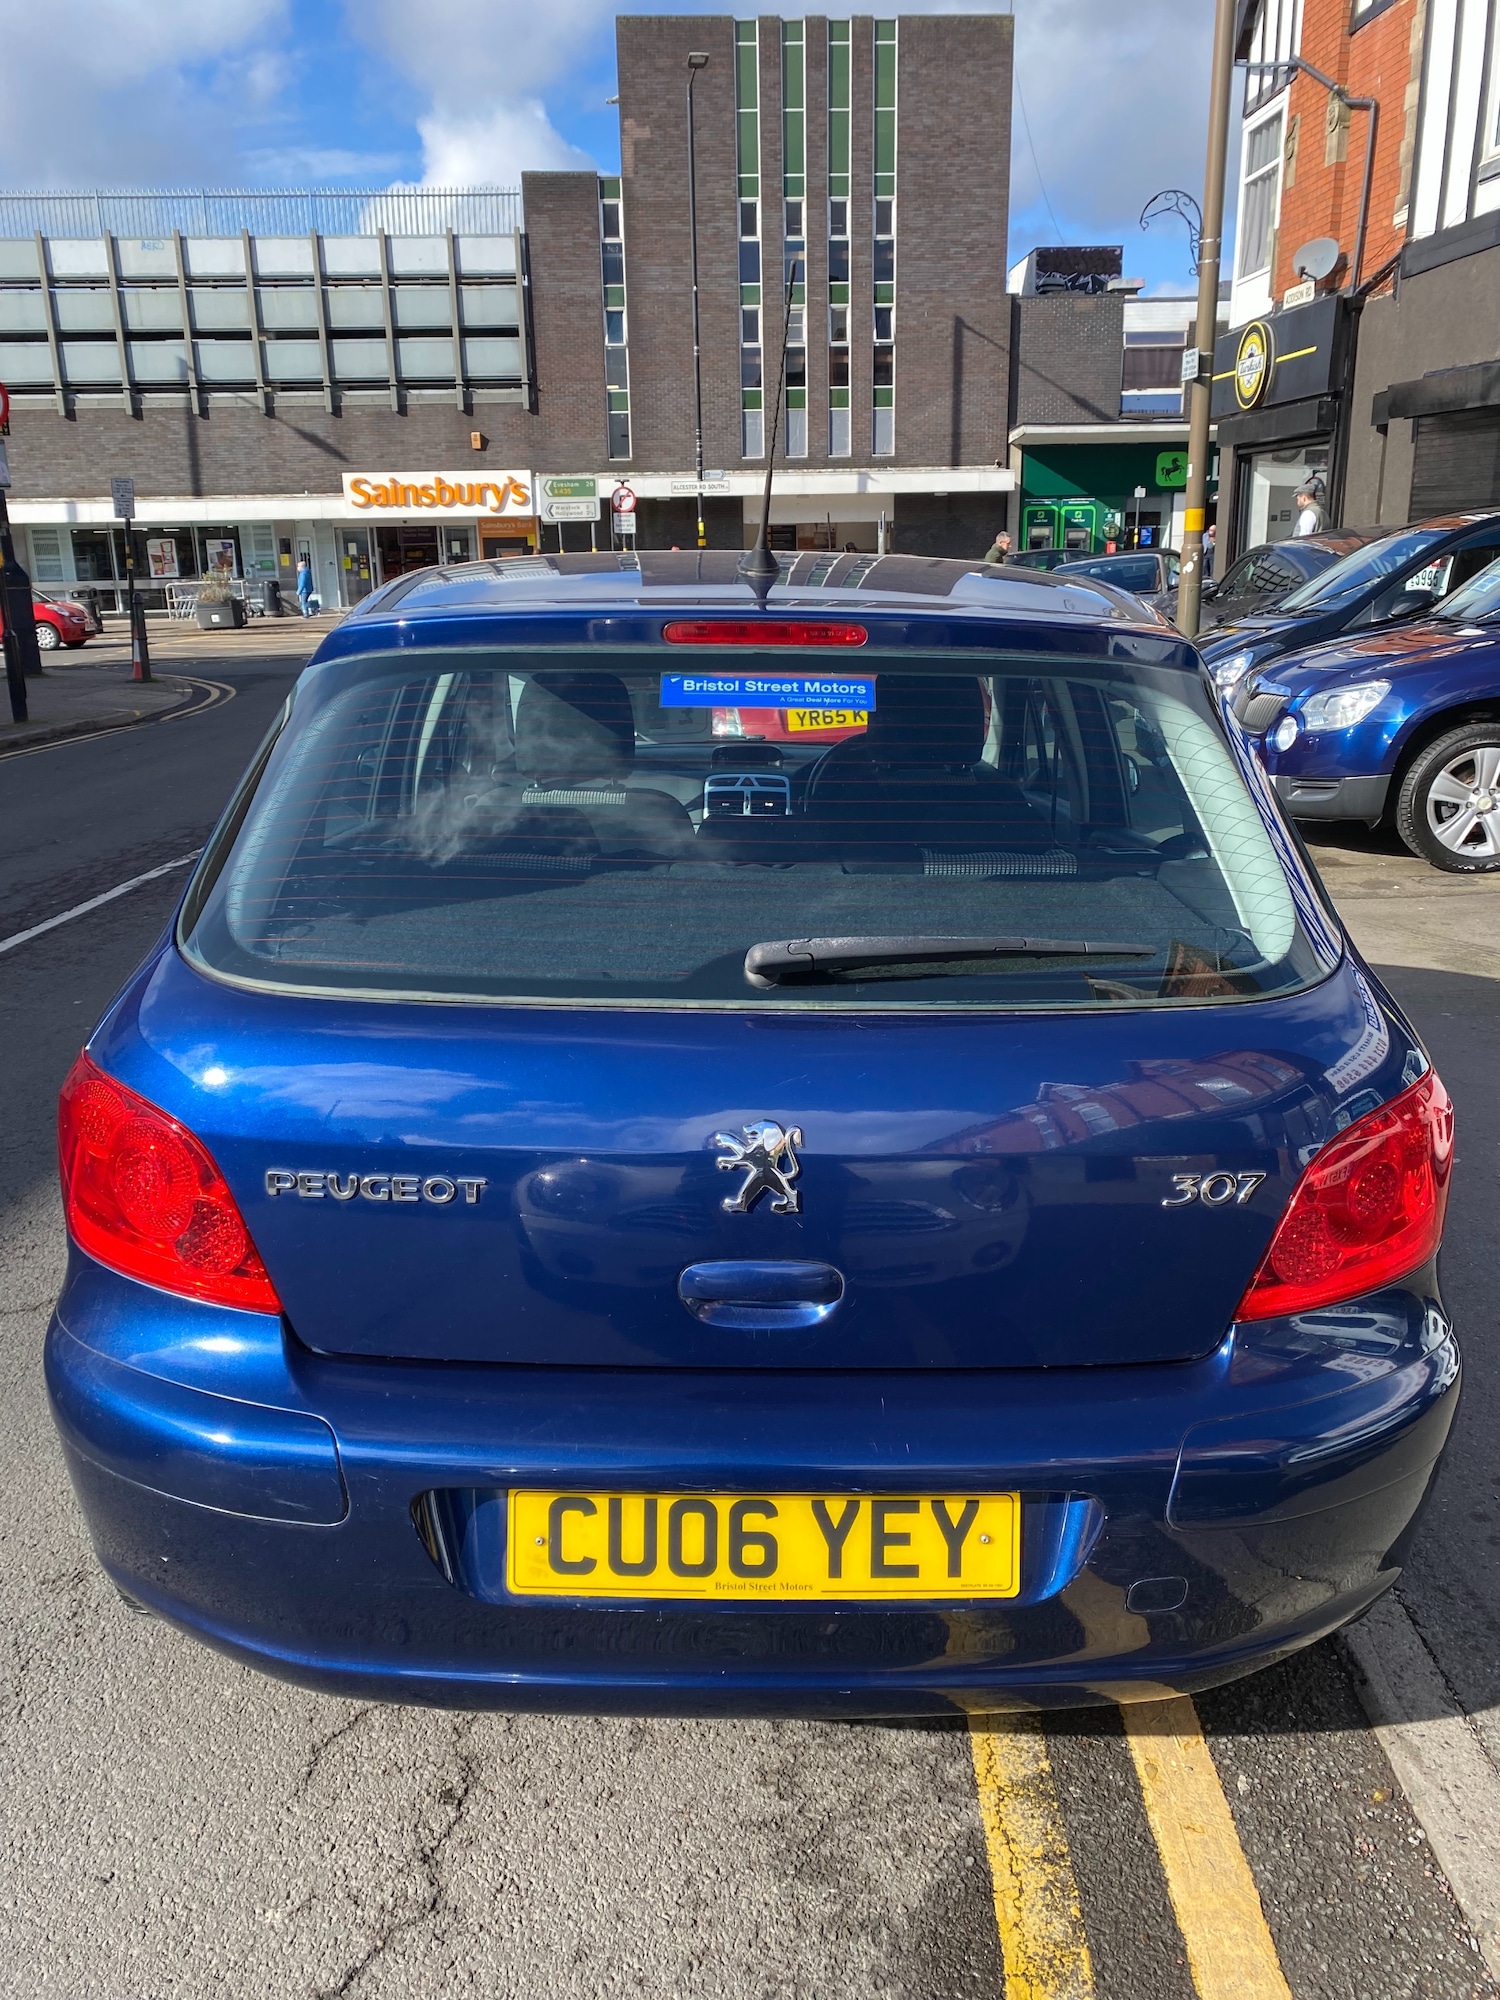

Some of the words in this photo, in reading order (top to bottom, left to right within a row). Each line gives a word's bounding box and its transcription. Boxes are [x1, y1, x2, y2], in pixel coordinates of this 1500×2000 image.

[1286, 290, 1304, 305] ADDISON
[1305, 285, 1312, 297] RD
[1239, 357, 1262, 374] Turkish
[350, 476, 530, 512] Sainsbury's
[481, 521, 516, 530] Sainsbury's
[683, 679, 739, 692] Bristol
[745, 680, 799, 693] Street
[804, 682, 866, 694] Motors
[796, 709, 846, 727] YR65
[266, 1171, 488, 1205] PEUGEOT
[1161, 1172, 1267, 1207] 307
[548, 1496, 778, 1577] CU06
[811, 1499, 980, 1579] YEY
[715, 1582, 746, 1590] Bristol
[749, 1582, 776, 1590] Street
[780, 1582, 813, 1591] Motors
